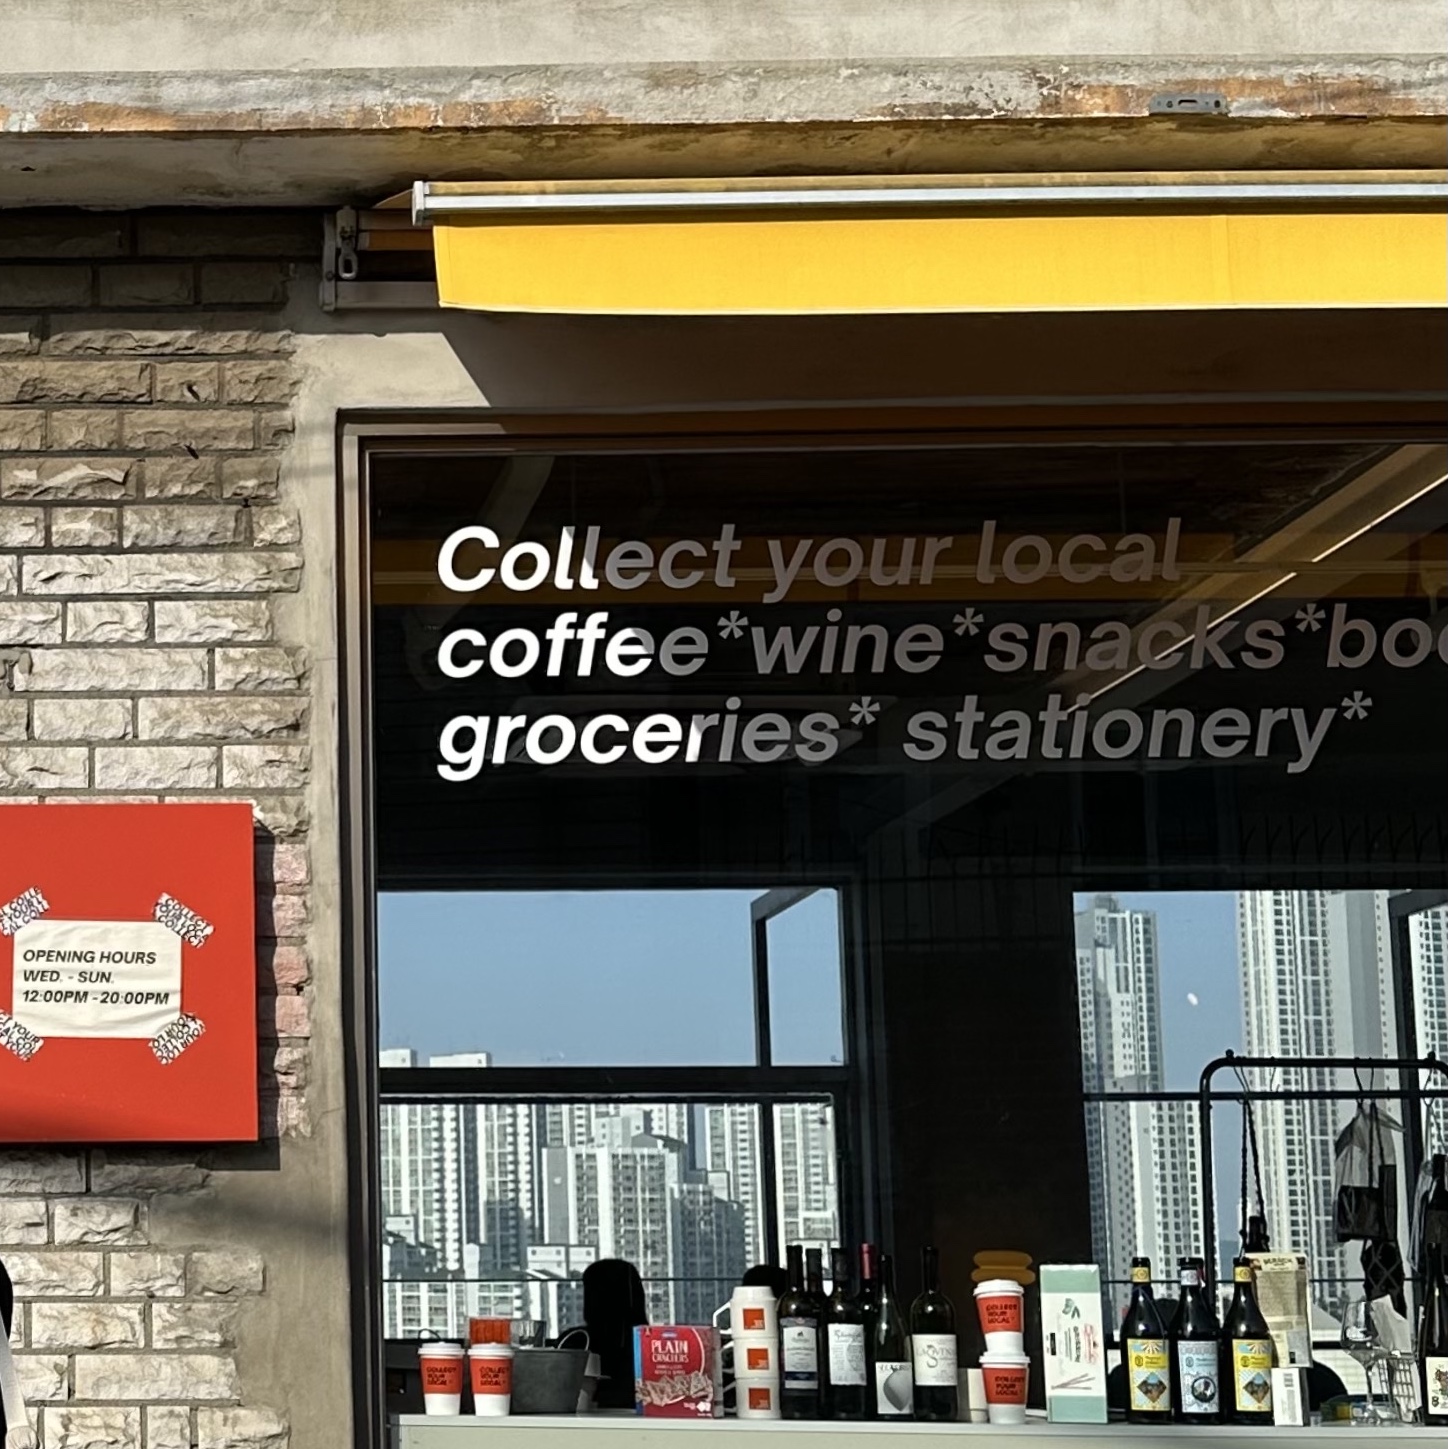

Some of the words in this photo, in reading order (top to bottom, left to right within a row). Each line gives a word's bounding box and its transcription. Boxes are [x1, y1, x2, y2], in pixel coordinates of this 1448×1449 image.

[436, 522, 742, 593] Collect
[762, 536, 953, 605] your
[974, 516, 1182, 585] local
[23, 949, 95, 964] OPENING
[99, 951, 157, 966] HOURS
[23, 970, 63, 983] WED.
[78, 971, 114, 984] SUN.
[22, 989, 89, 1003] 12:00PM
[652, 1340, 688, 1353] PLAIN
